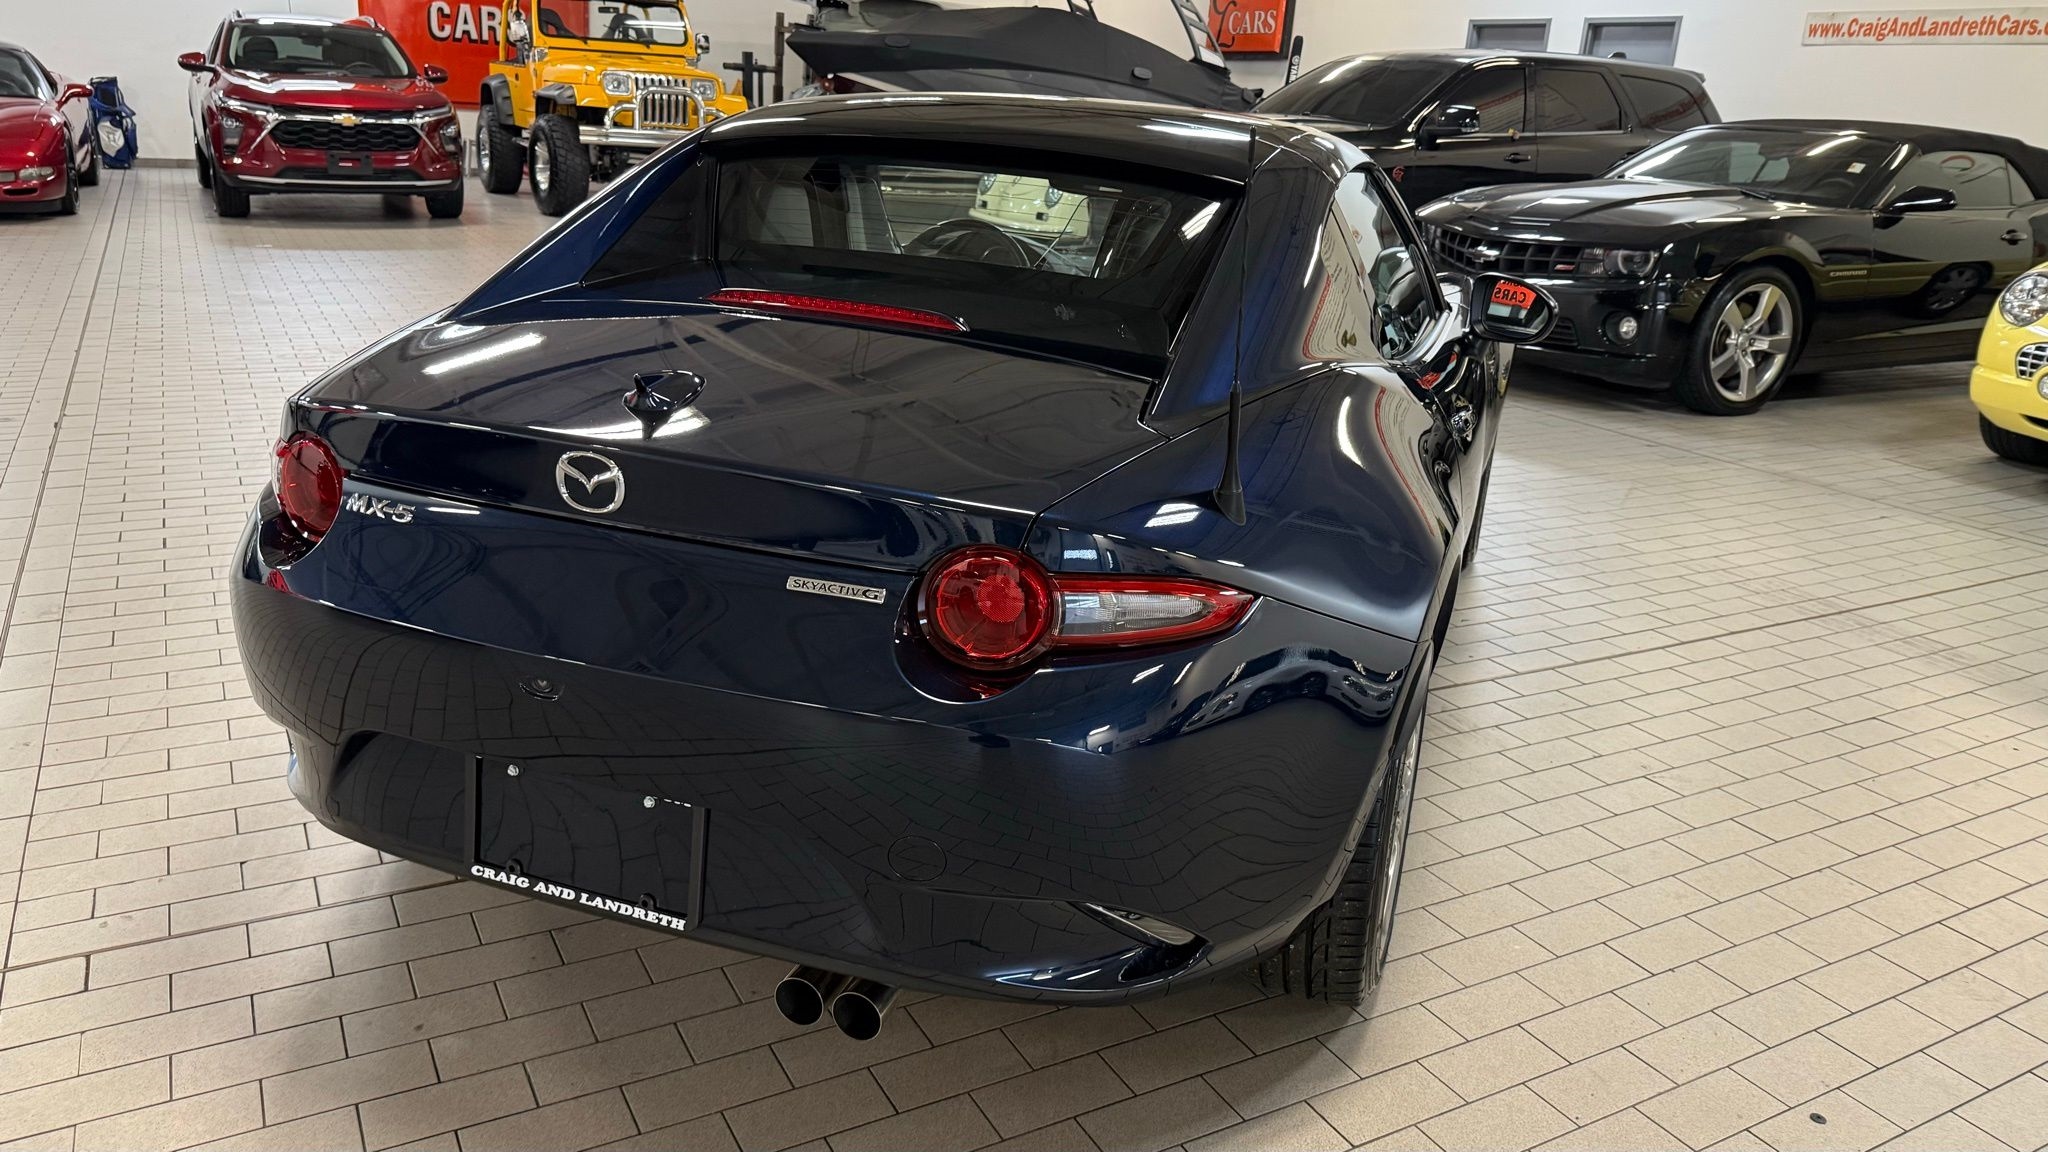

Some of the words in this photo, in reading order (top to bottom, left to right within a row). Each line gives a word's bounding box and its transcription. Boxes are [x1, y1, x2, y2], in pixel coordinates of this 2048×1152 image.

[1227, 9, 1278, 35] CARS
[345, 493, 416, 523] MX-5
[471, 865, 530, 888] CRAIG
[533, 881, 576, 900] AND
[579, 892, 687, 931] LANDRETH
